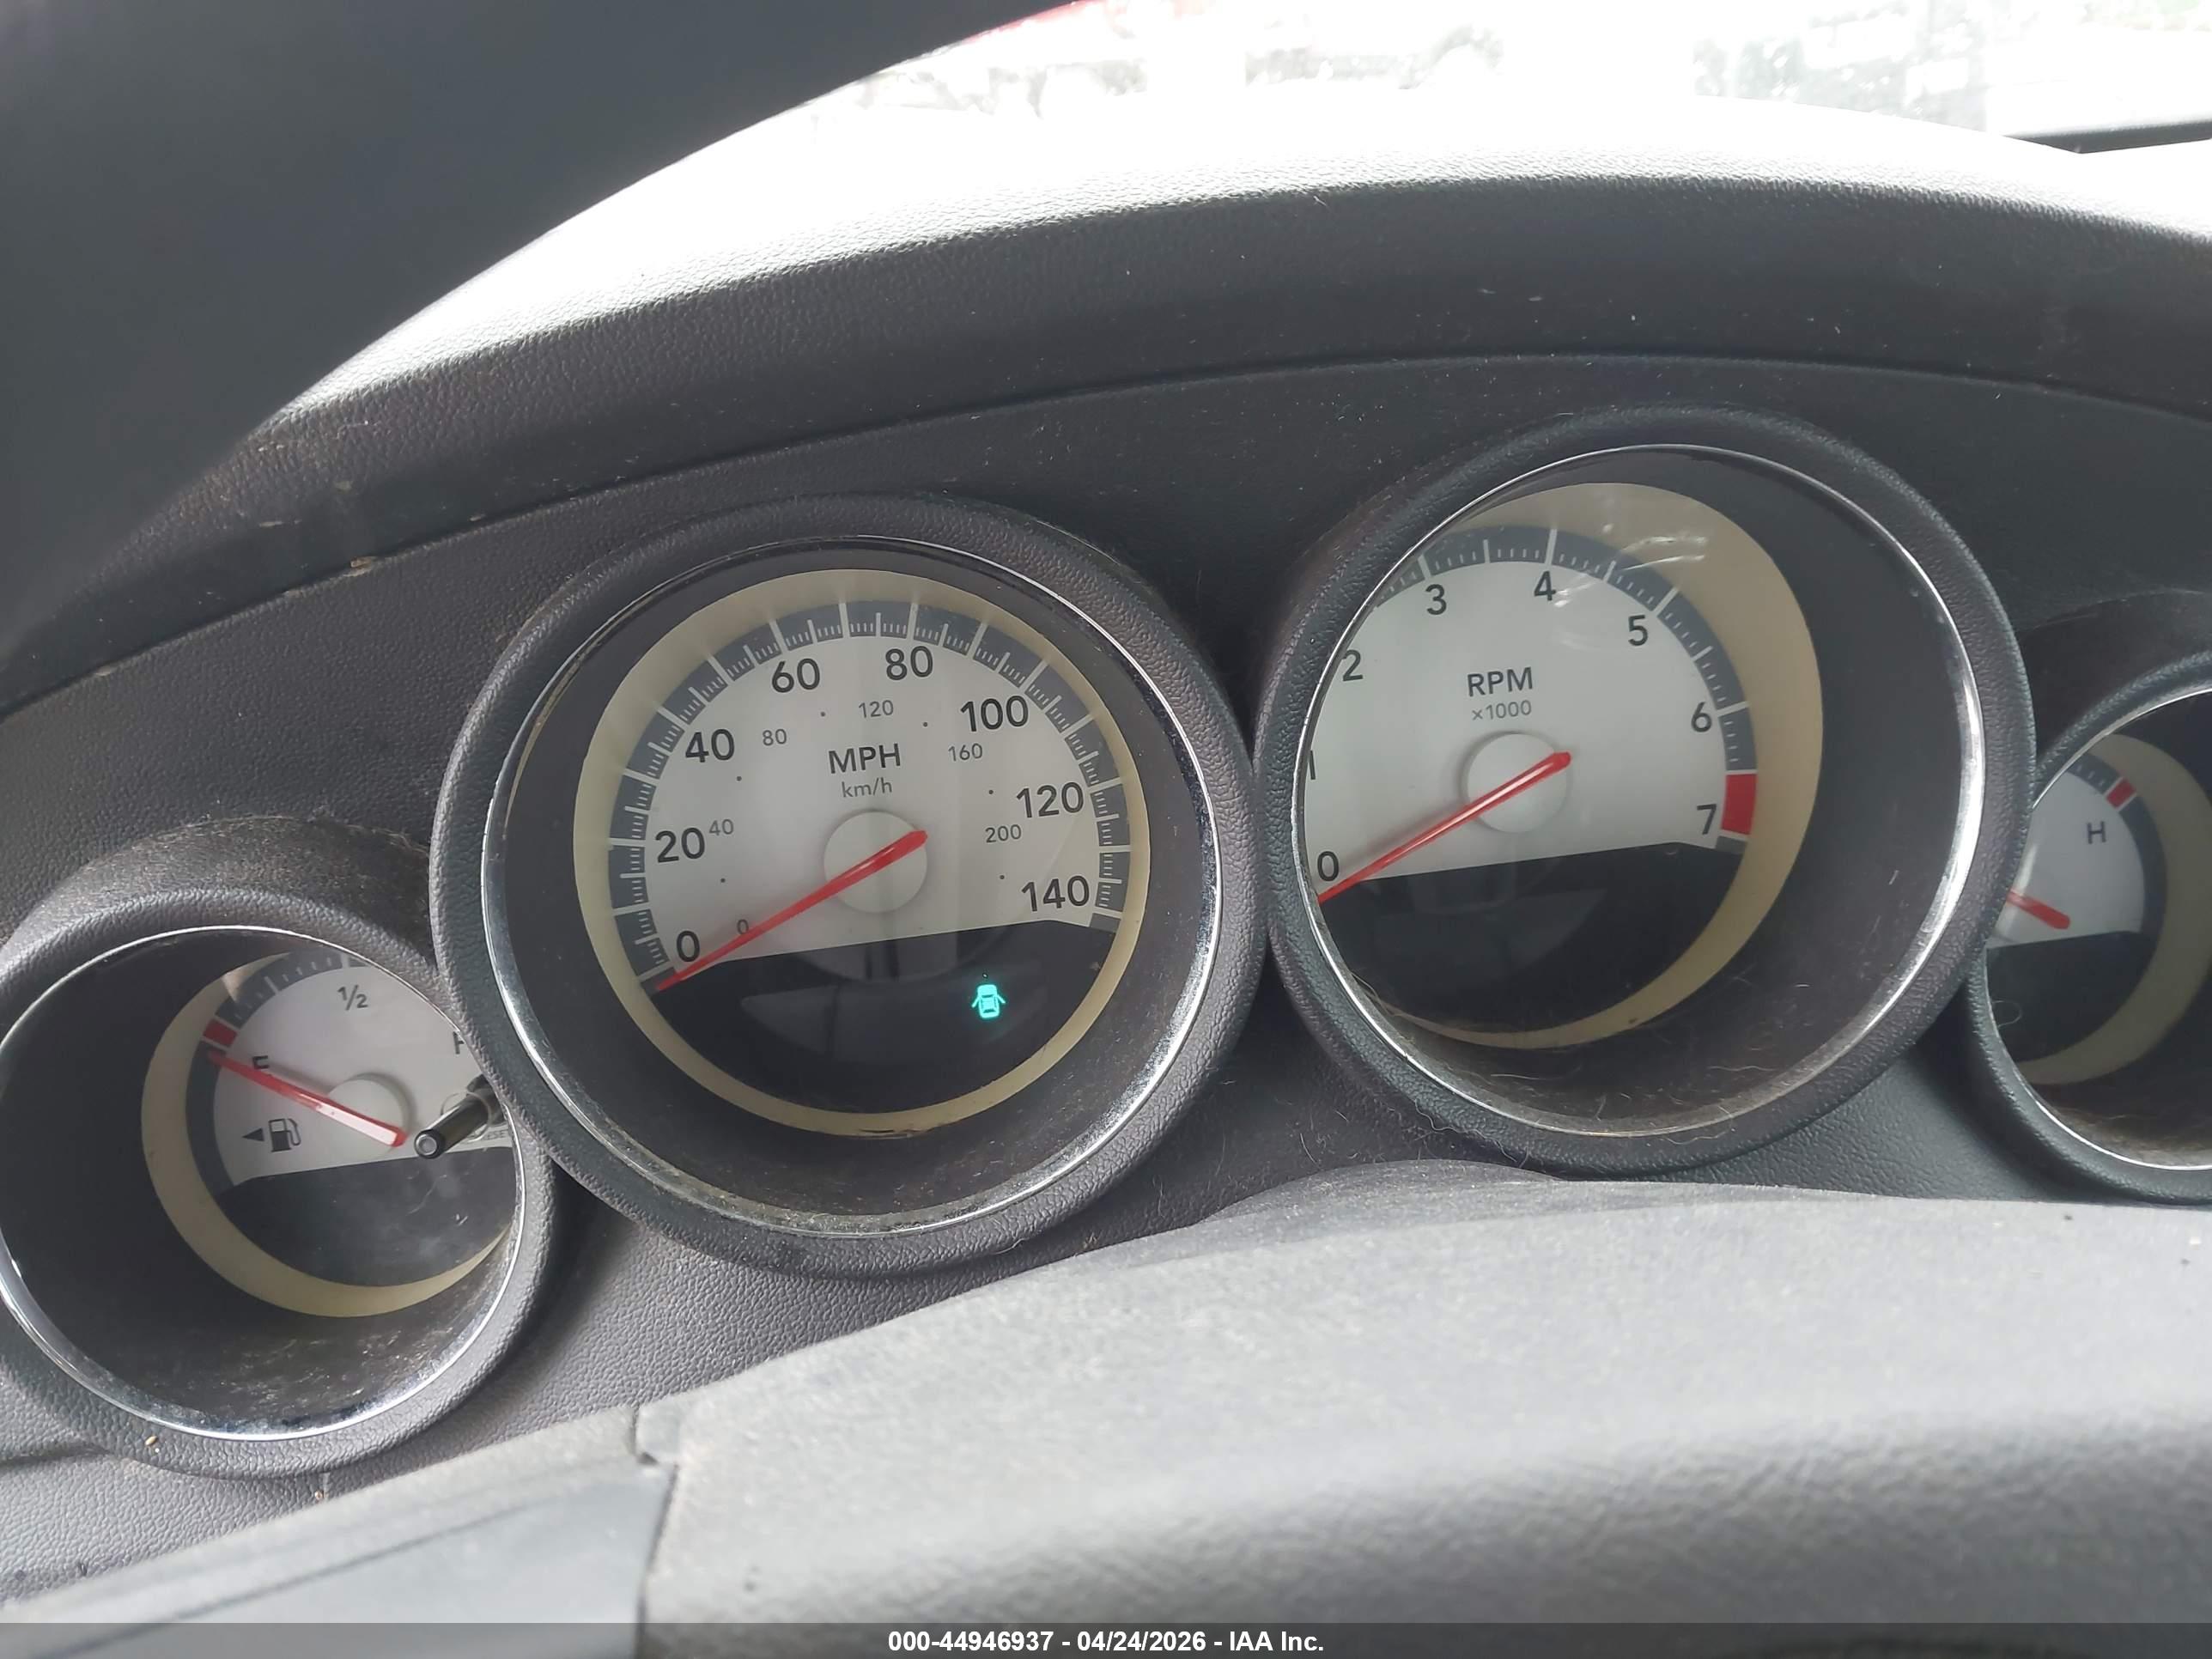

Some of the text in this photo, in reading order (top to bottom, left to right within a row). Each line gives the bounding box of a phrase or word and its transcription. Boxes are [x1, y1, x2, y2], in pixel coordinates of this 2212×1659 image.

[1425, 584, 1448, 615] 3
[1533, 571, 1557, 601] 4
[1628, 615, 1650, 646] 5
[771, 658, 822, 693] 60
[884, 645, 934, 681] 80
[1341, 650, 1364, 682] 2
[1467, 666, 1534, 696] RPM
[859, 700, 895, 718] 120
[960, 695, 1030, 732] 100
[1690, 702, 1713, 732] 6
[685, 728, 735, 763] 40
[762, 728, 788, 747] 80
[947, 743, 983, 762] 160
[828, 744, 902, 775] MPH
[841, 778, 894, 798] km/h
[1016, 781, 1085, 818] 120
[708, 817, 735, 836] 40
[984, 823, 1022, 843] 200
[1696, 804, 1718, 836] 7
[2087, 821, 2106, 844] H
[655, 827, 707, 863] 20
[1317, 851, 1340, 882] 0
[1020, 875, 1091, 912] 140
[676, 930, 701, 963] 0
